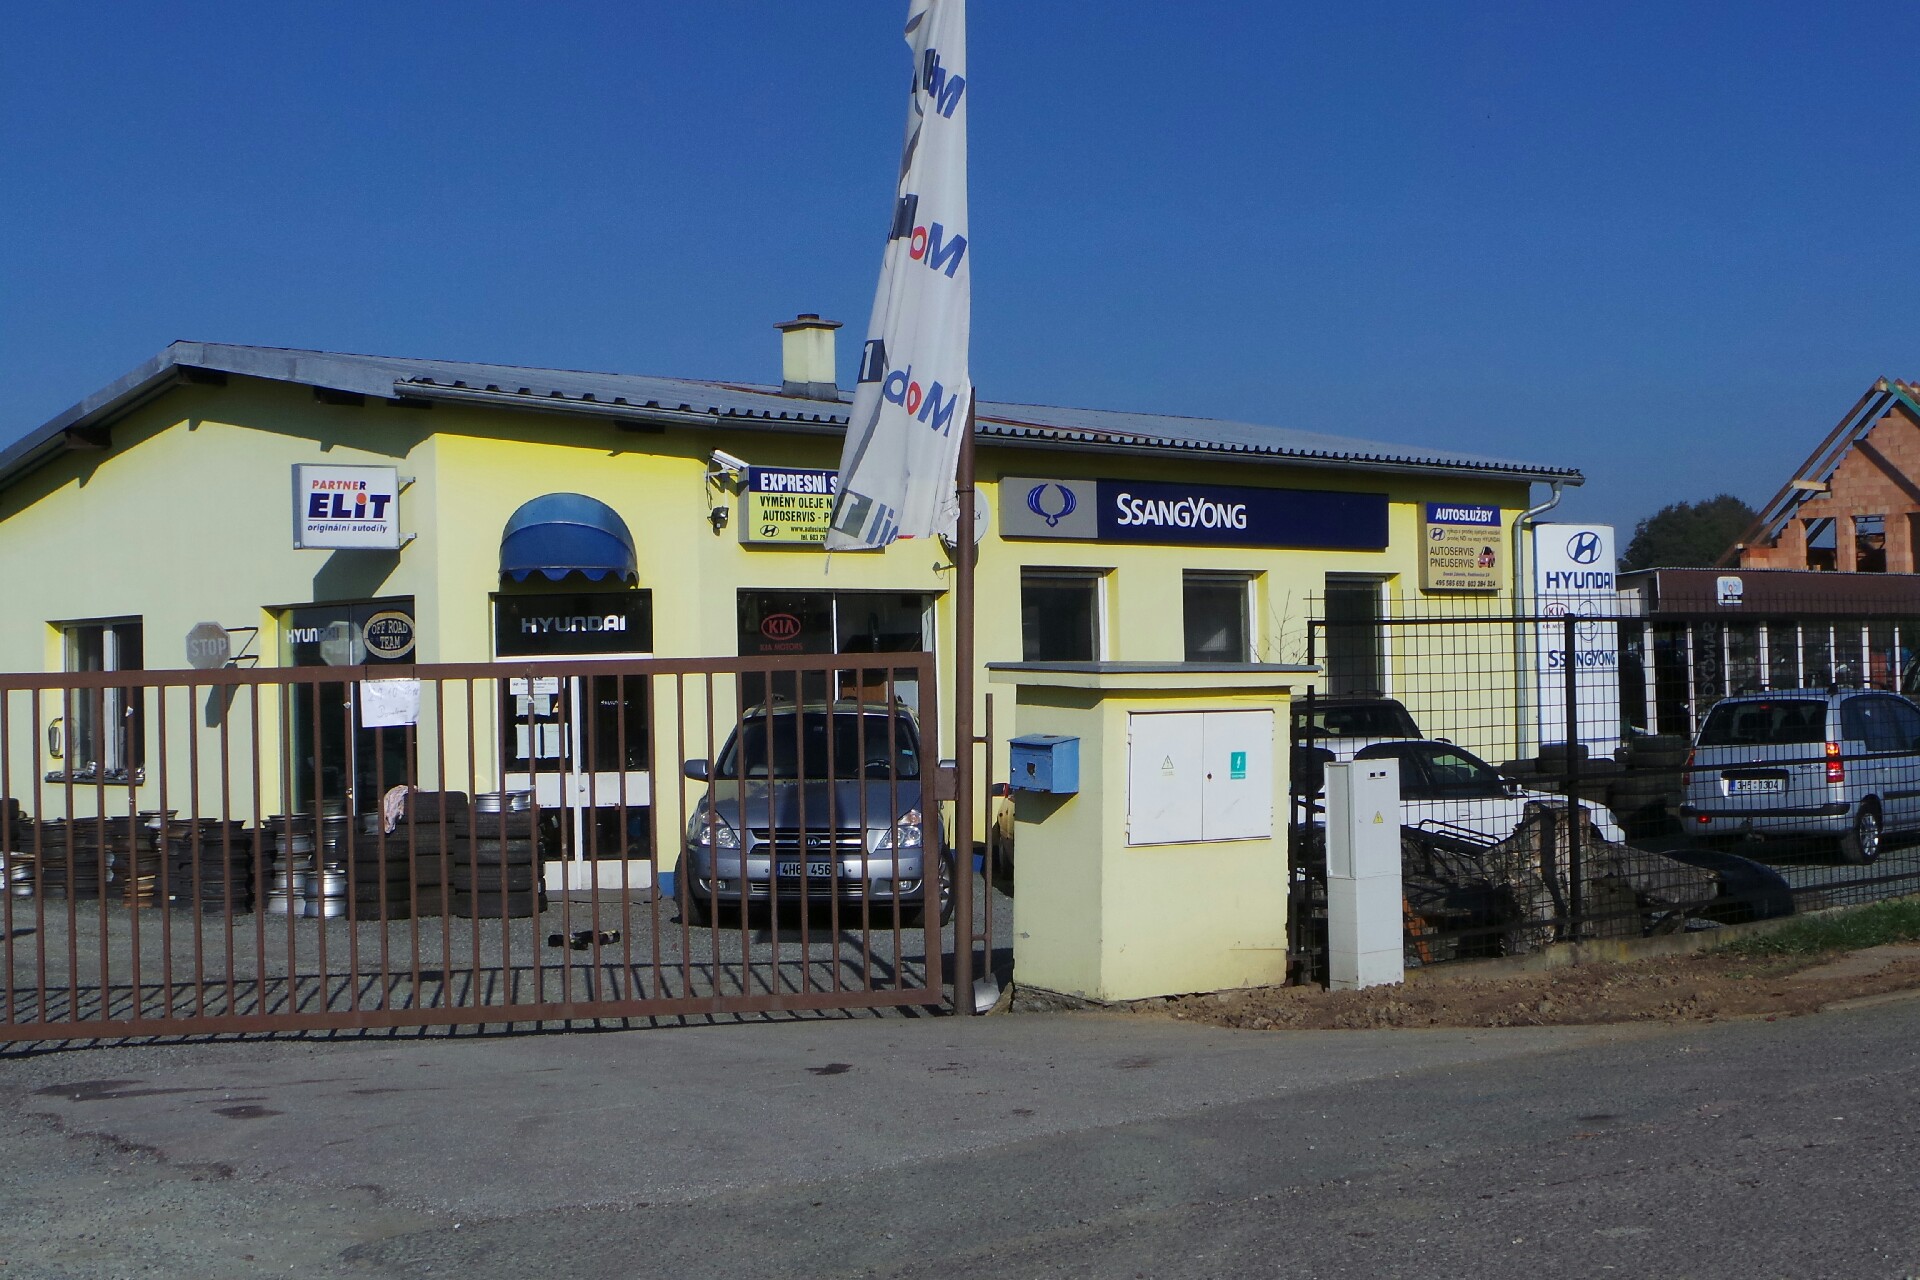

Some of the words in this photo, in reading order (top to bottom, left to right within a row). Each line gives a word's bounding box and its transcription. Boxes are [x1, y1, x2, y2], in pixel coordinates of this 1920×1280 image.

[312, 480, 367, 490] PARTNER
[760, 472, 827, 493] EXPRESNÍ
[829, 477, 838, 493] S
[760, 494, 796, 508] VÝMĚNY
[798, 496, 824, 508] OLEJE
[763, 510, 816, 522] AUTOSERVIS
[1435, 507, 1493, 522] AUTOSLUŽBY
[1429, 546, 1474, 557] AUTOSERVIS
[1430, 558, 1474, 568] PNEUSERVIS
[1546, 571, 1613, 589] HYUNDAI
[371, 621, 386, 634] OFF
[388, 620, 408, 634] ROAD
[522, 615, 626, 633] HYUNDAI
[768, 620, 794, 633] KIA
[190, 638, 227, 657] STOP
[380, 636, 400, 649] TEAM
[811, 864, 838, 876] 456
